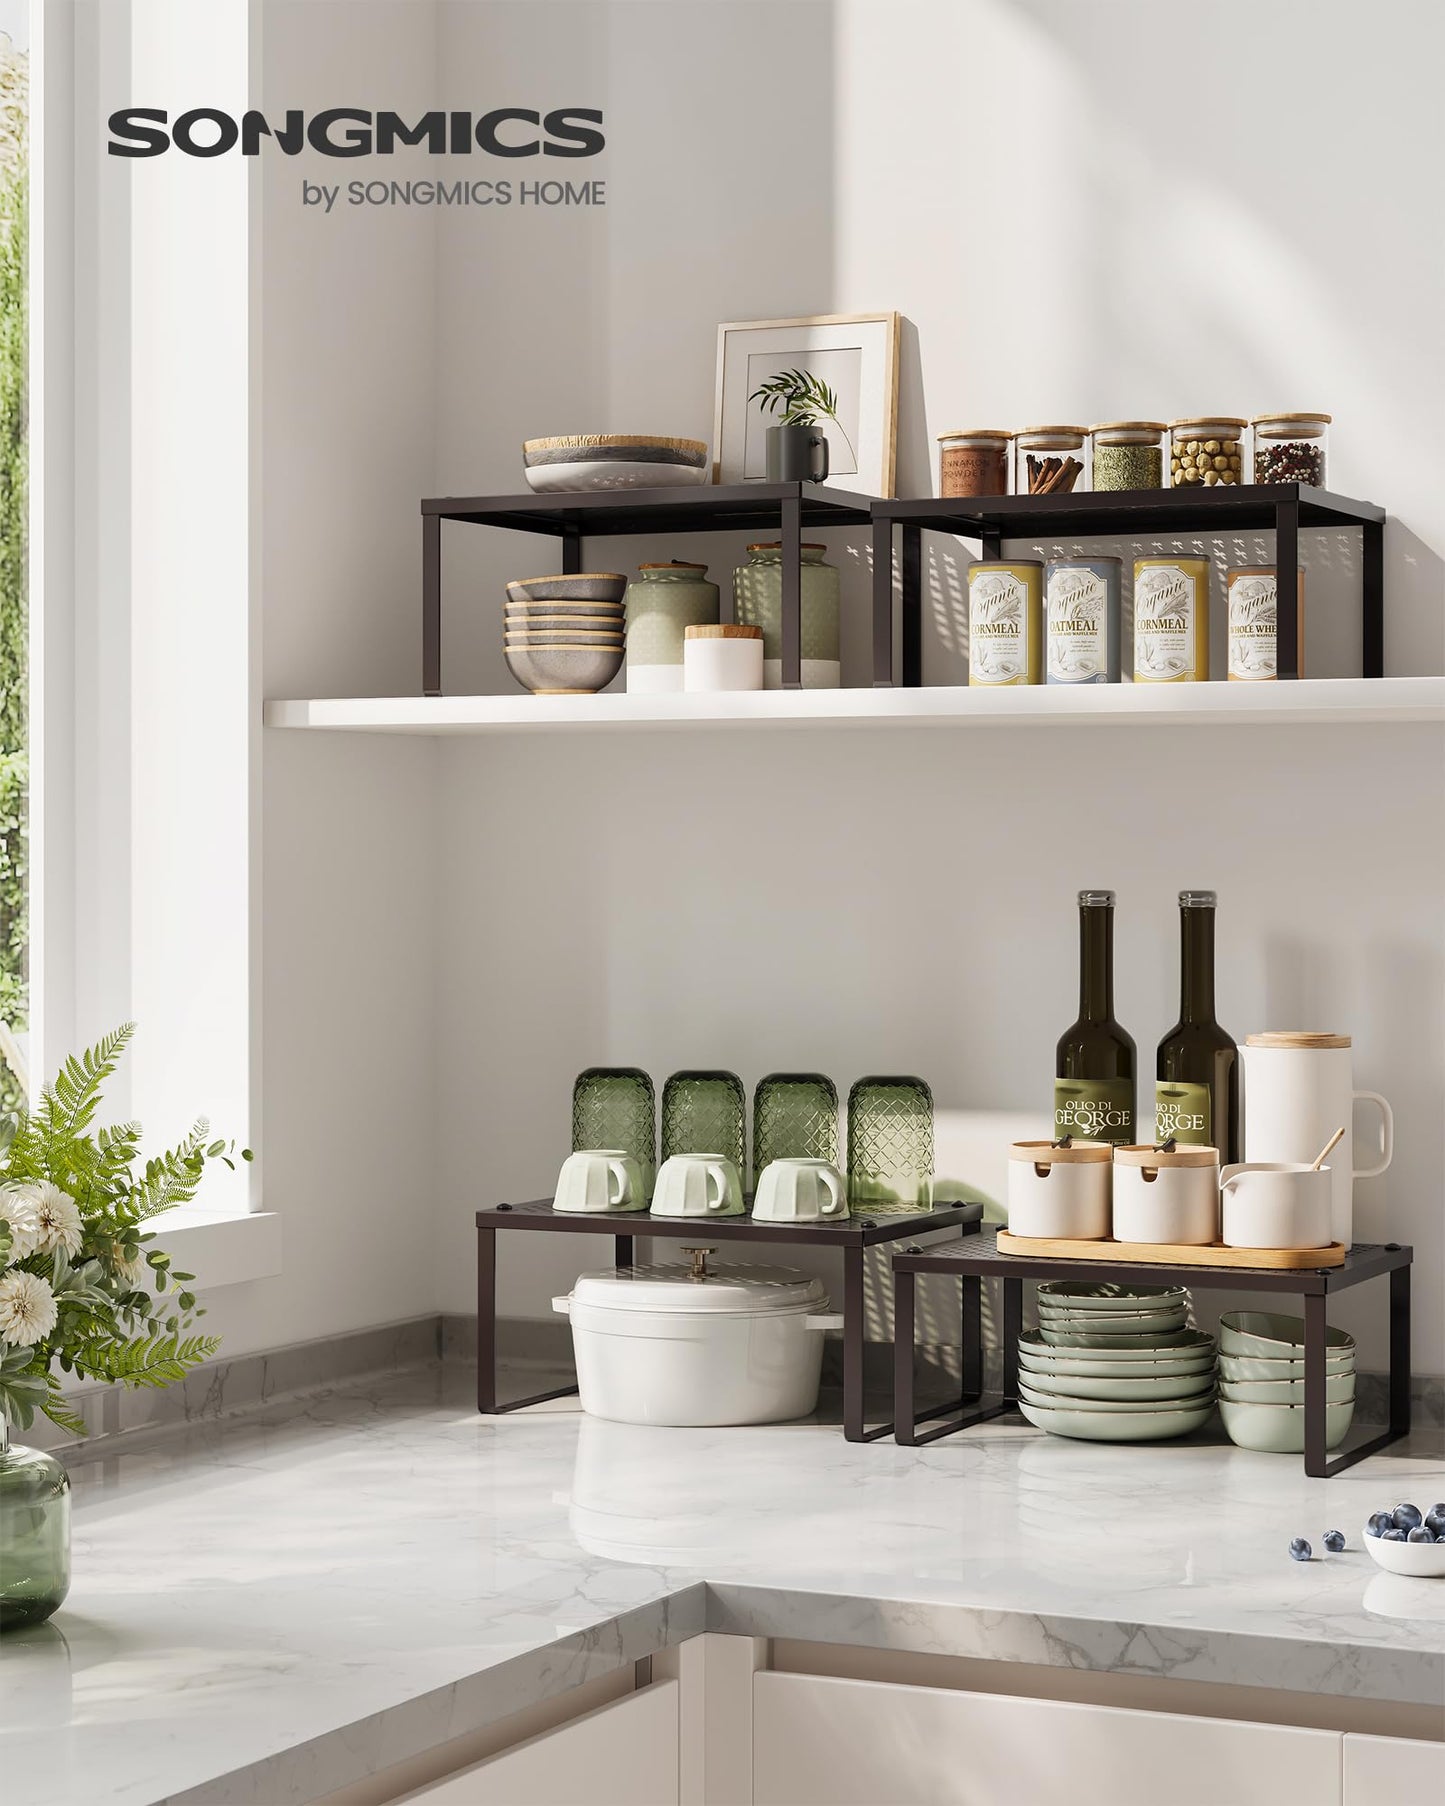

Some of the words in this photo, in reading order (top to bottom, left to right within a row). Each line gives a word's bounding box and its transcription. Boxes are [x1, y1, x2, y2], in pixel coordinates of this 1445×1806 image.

[972, 623, 1021, 635] CORNMEAL
[1050, 620, 1098, 632] OATMEAL
[1137, 618, 1188, 630] CORNMEAL
[1230, 625, 1254, 634] WHOLE
[1255, 625, 1278, 633] WHE
[1065, 1100, 1096, 1111] OLIO
[1098, 1101, 1112, 1111] DI
[1169, 1103, 1181, 1113] DI
[1055, 1108, 1131, 1127] GEORGE
[1156, 1112, 1205, 1130] ORGE
